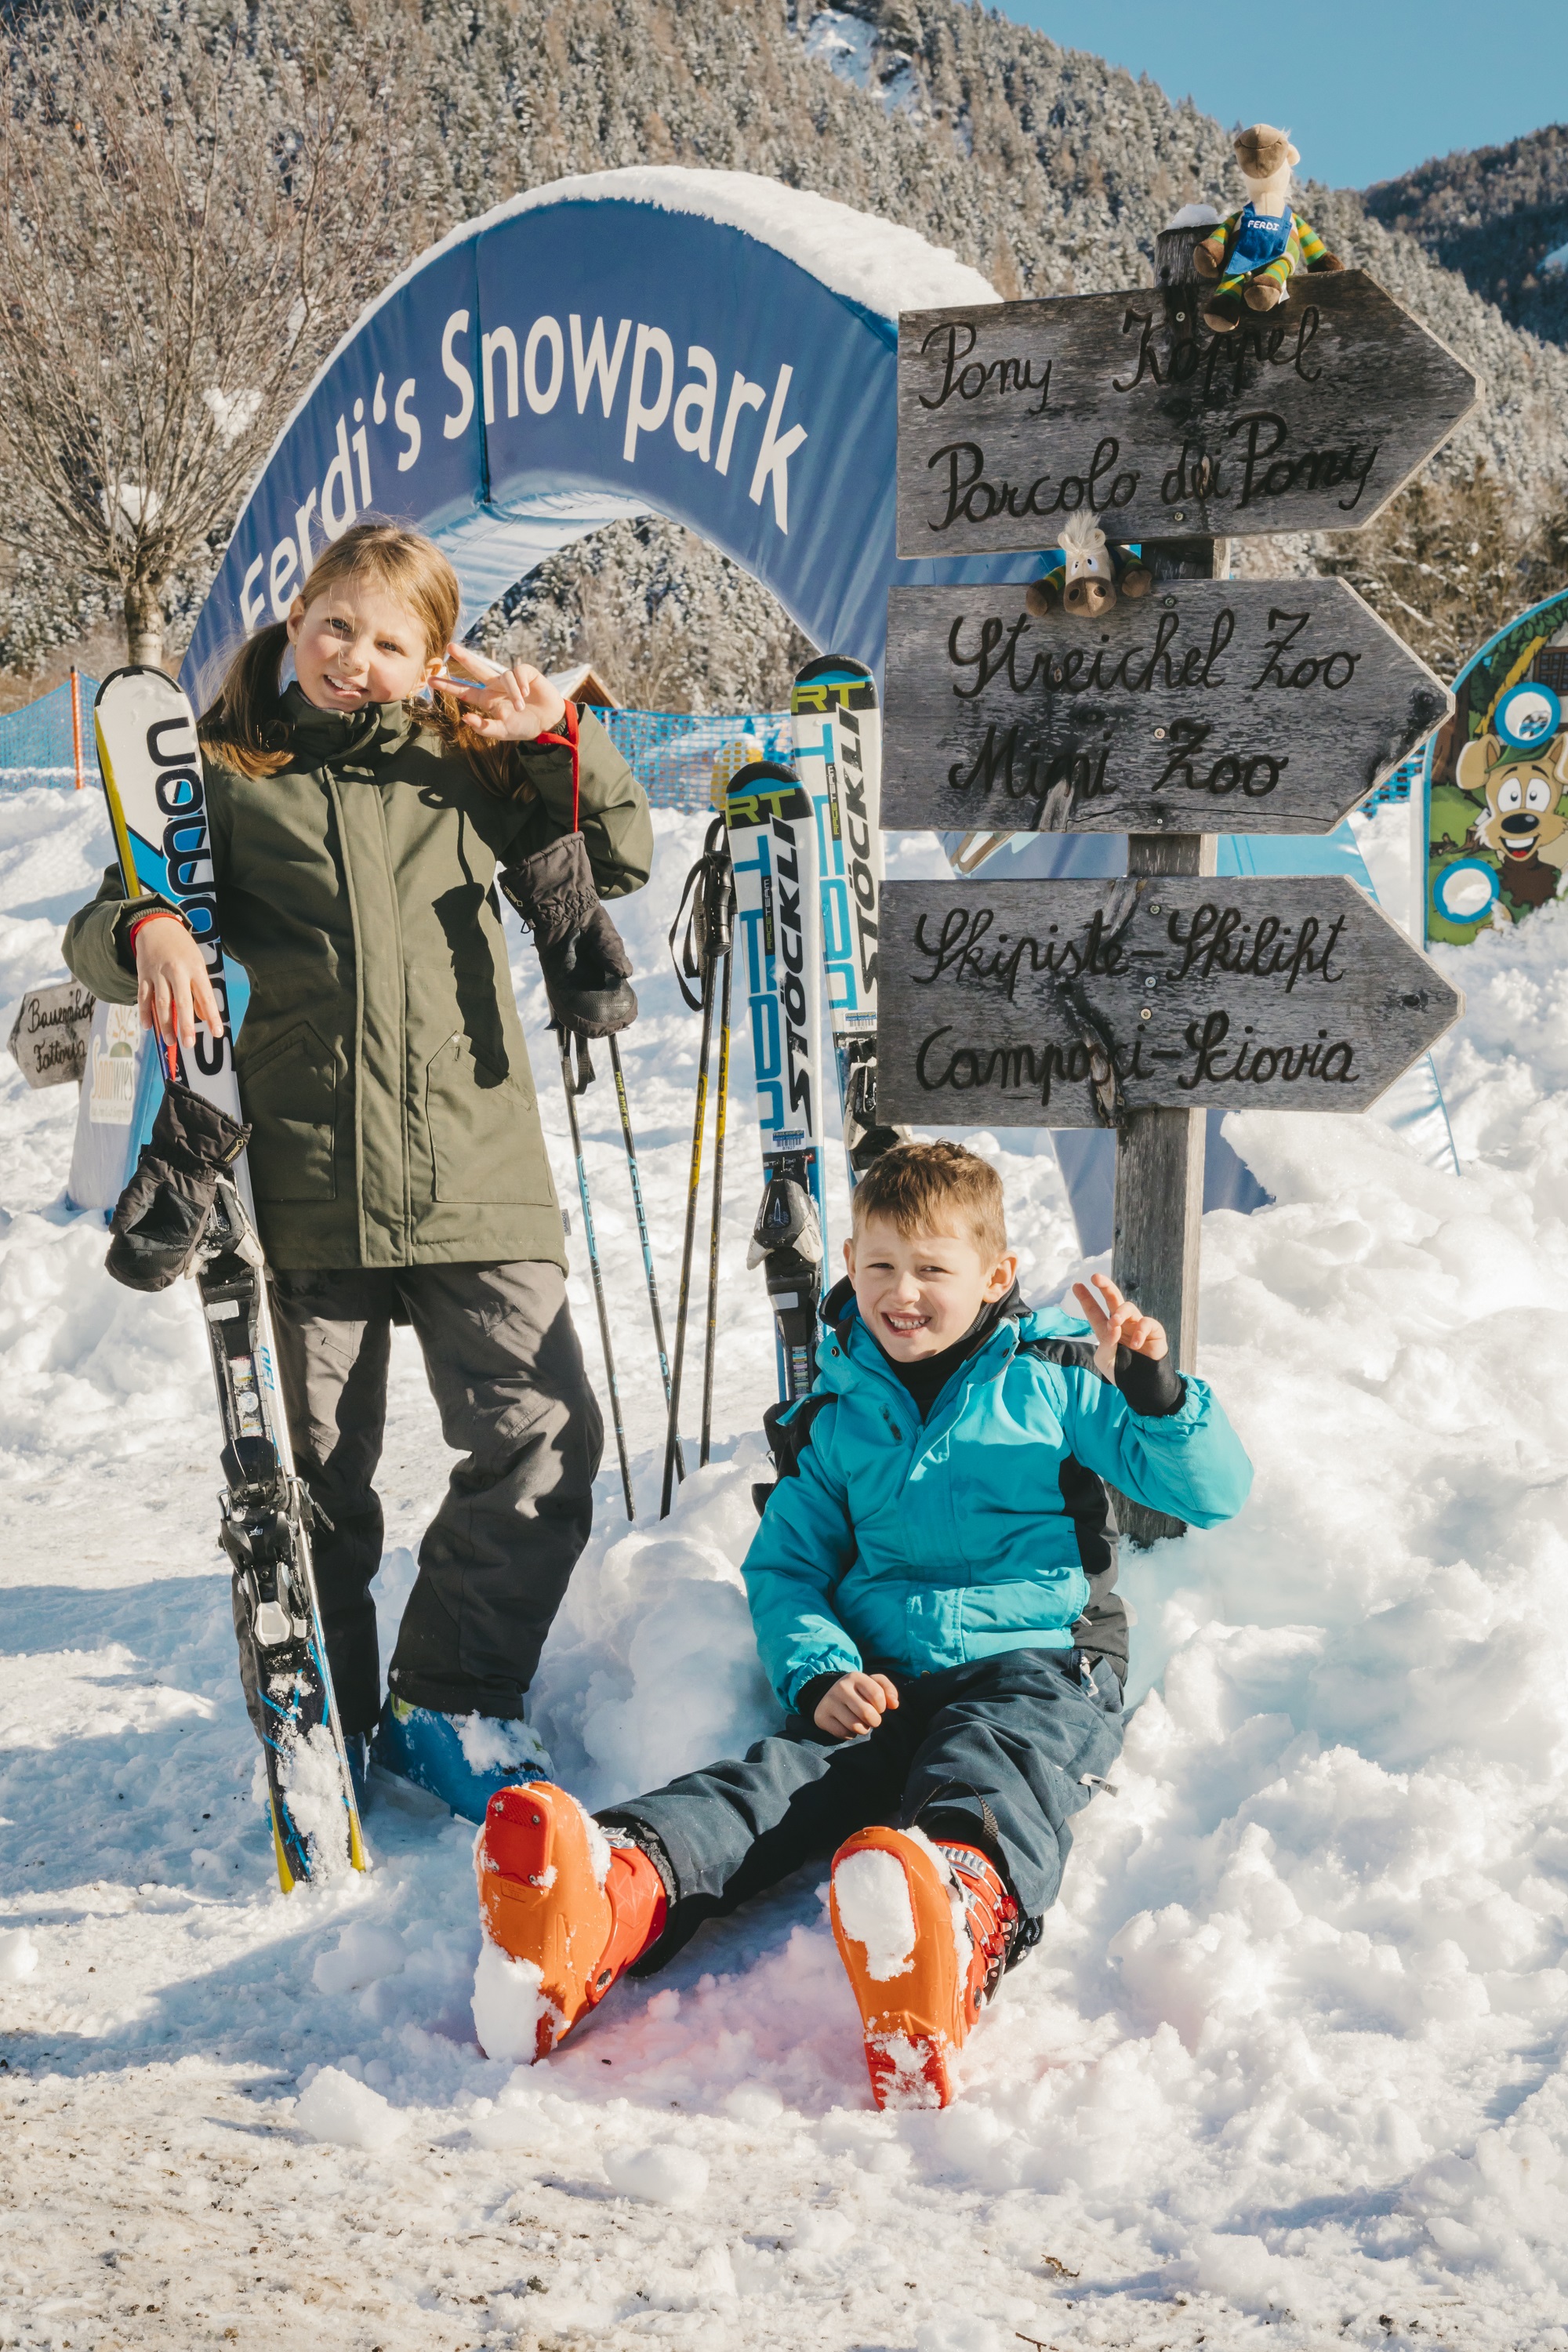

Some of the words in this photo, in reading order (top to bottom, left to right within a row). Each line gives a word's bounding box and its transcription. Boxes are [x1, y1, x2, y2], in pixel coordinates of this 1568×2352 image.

[1247, 220, 1280, 231] FERDI
[918, 321, 1052, 415] Pony
[441, 309, 808, 535] Snowpark
[1228, 410, 1386, 511] Pony
[790, 681, 866, 713] RT
[949, 608, 1235, 699] Streichel
[1252, 608, 1362, 690] Zoo
[948, 724, 1117, 799] Mini
[1151, 717, 1290, 797] Zoo
[726, 788, 797, 827] RT
[837, 707, 878, 995] STÖCKLI
[772, 815, 813, 1138] STÖCKLI
